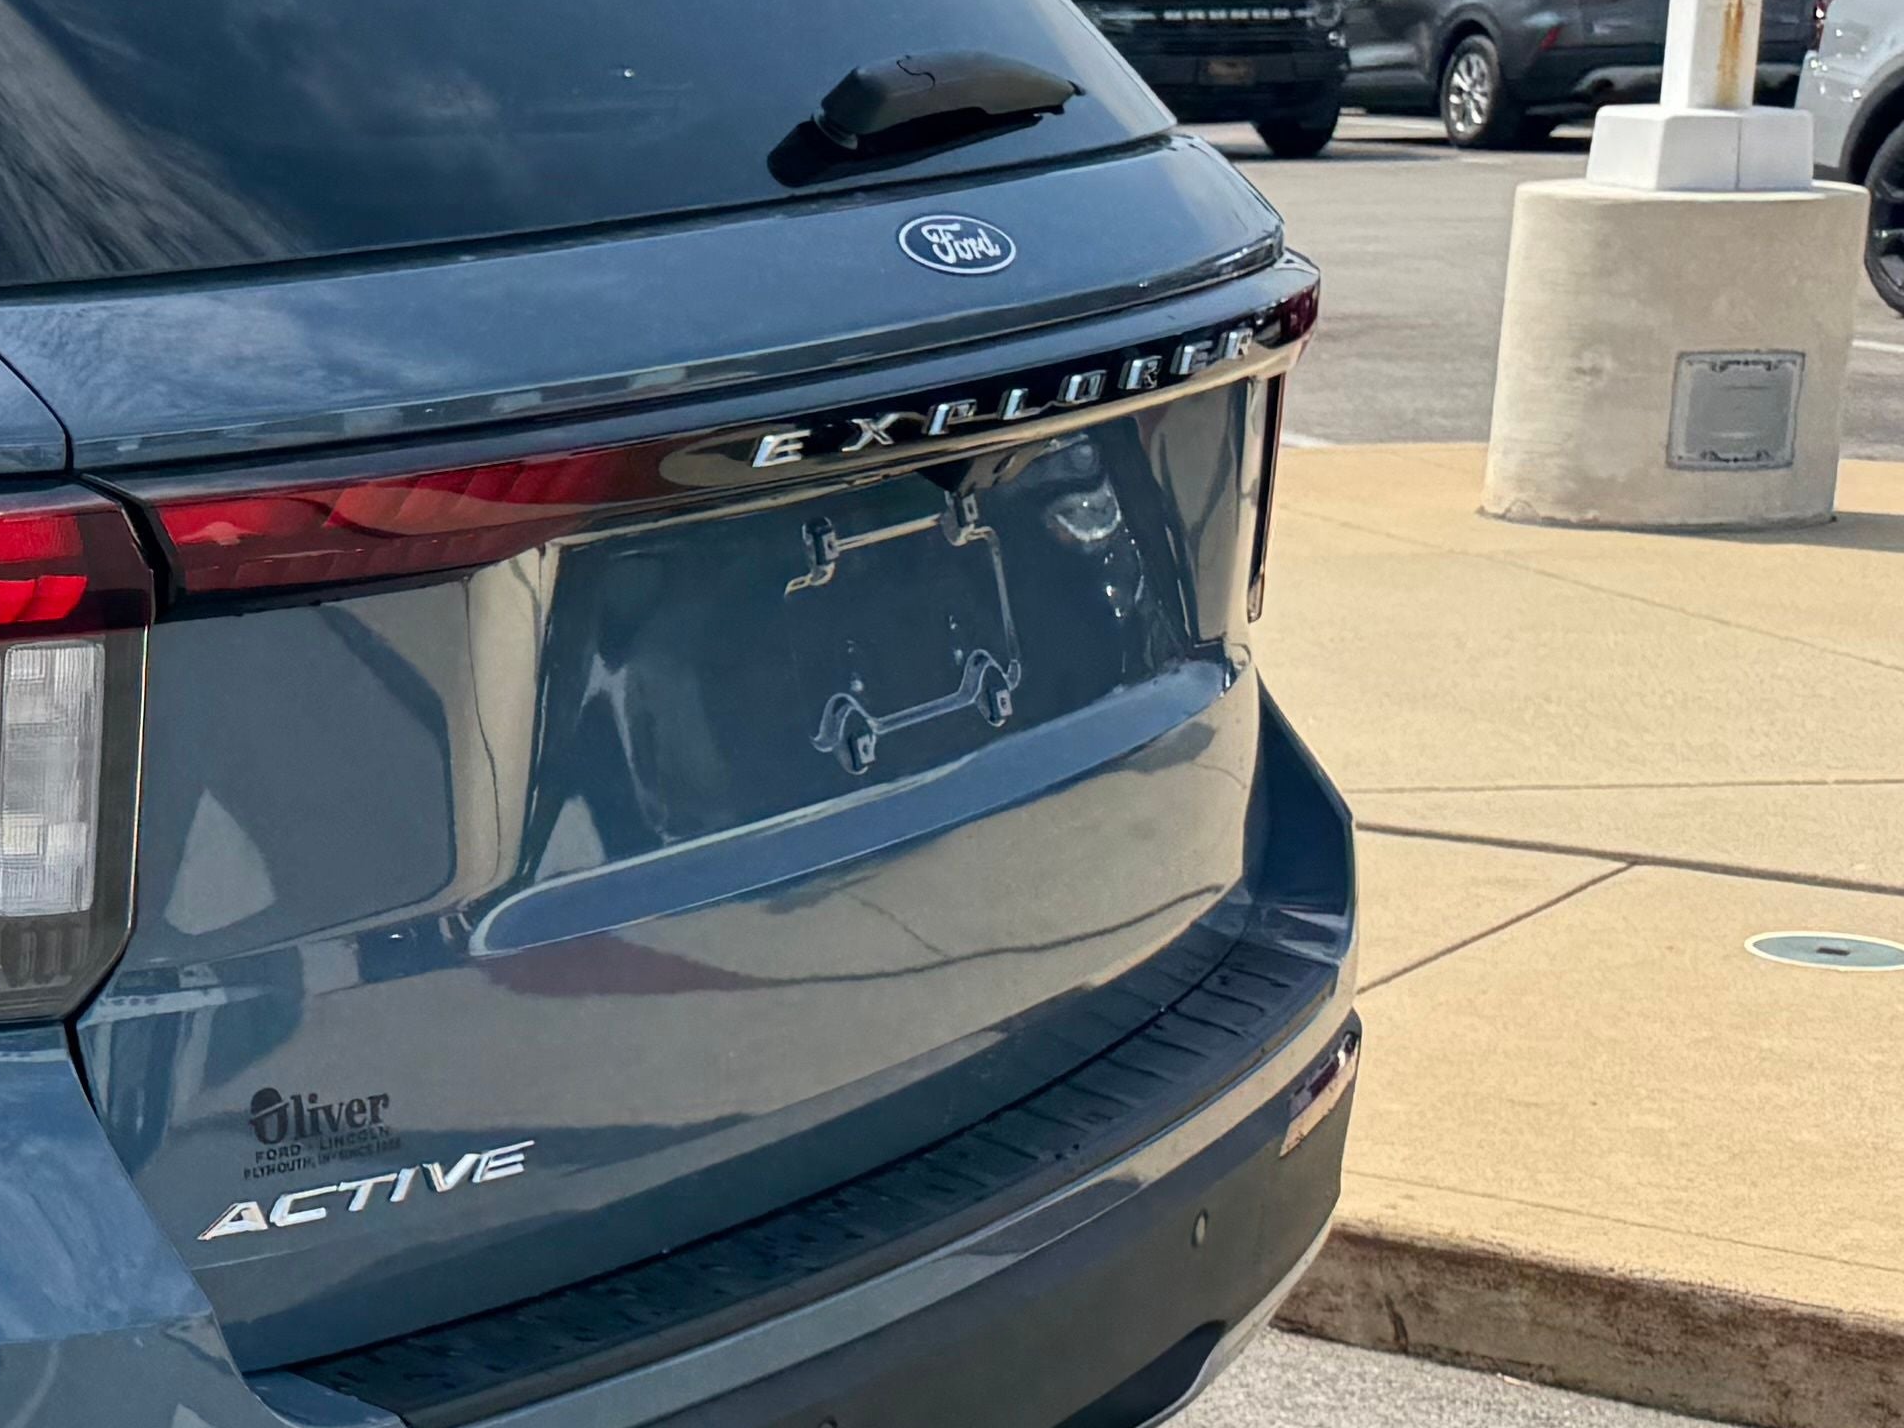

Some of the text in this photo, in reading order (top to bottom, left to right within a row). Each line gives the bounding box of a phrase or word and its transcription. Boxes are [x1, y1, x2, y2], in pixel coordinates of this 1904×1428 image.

[921, 223, 1001, 264] Ford
[751, 327, 1254, 468] EXPLORER
[248, 1087, 390, 1145] Oliver
[255, 1144, 302, 1164] FORD
[197, 1139, 535, 1241] ACTIVE
